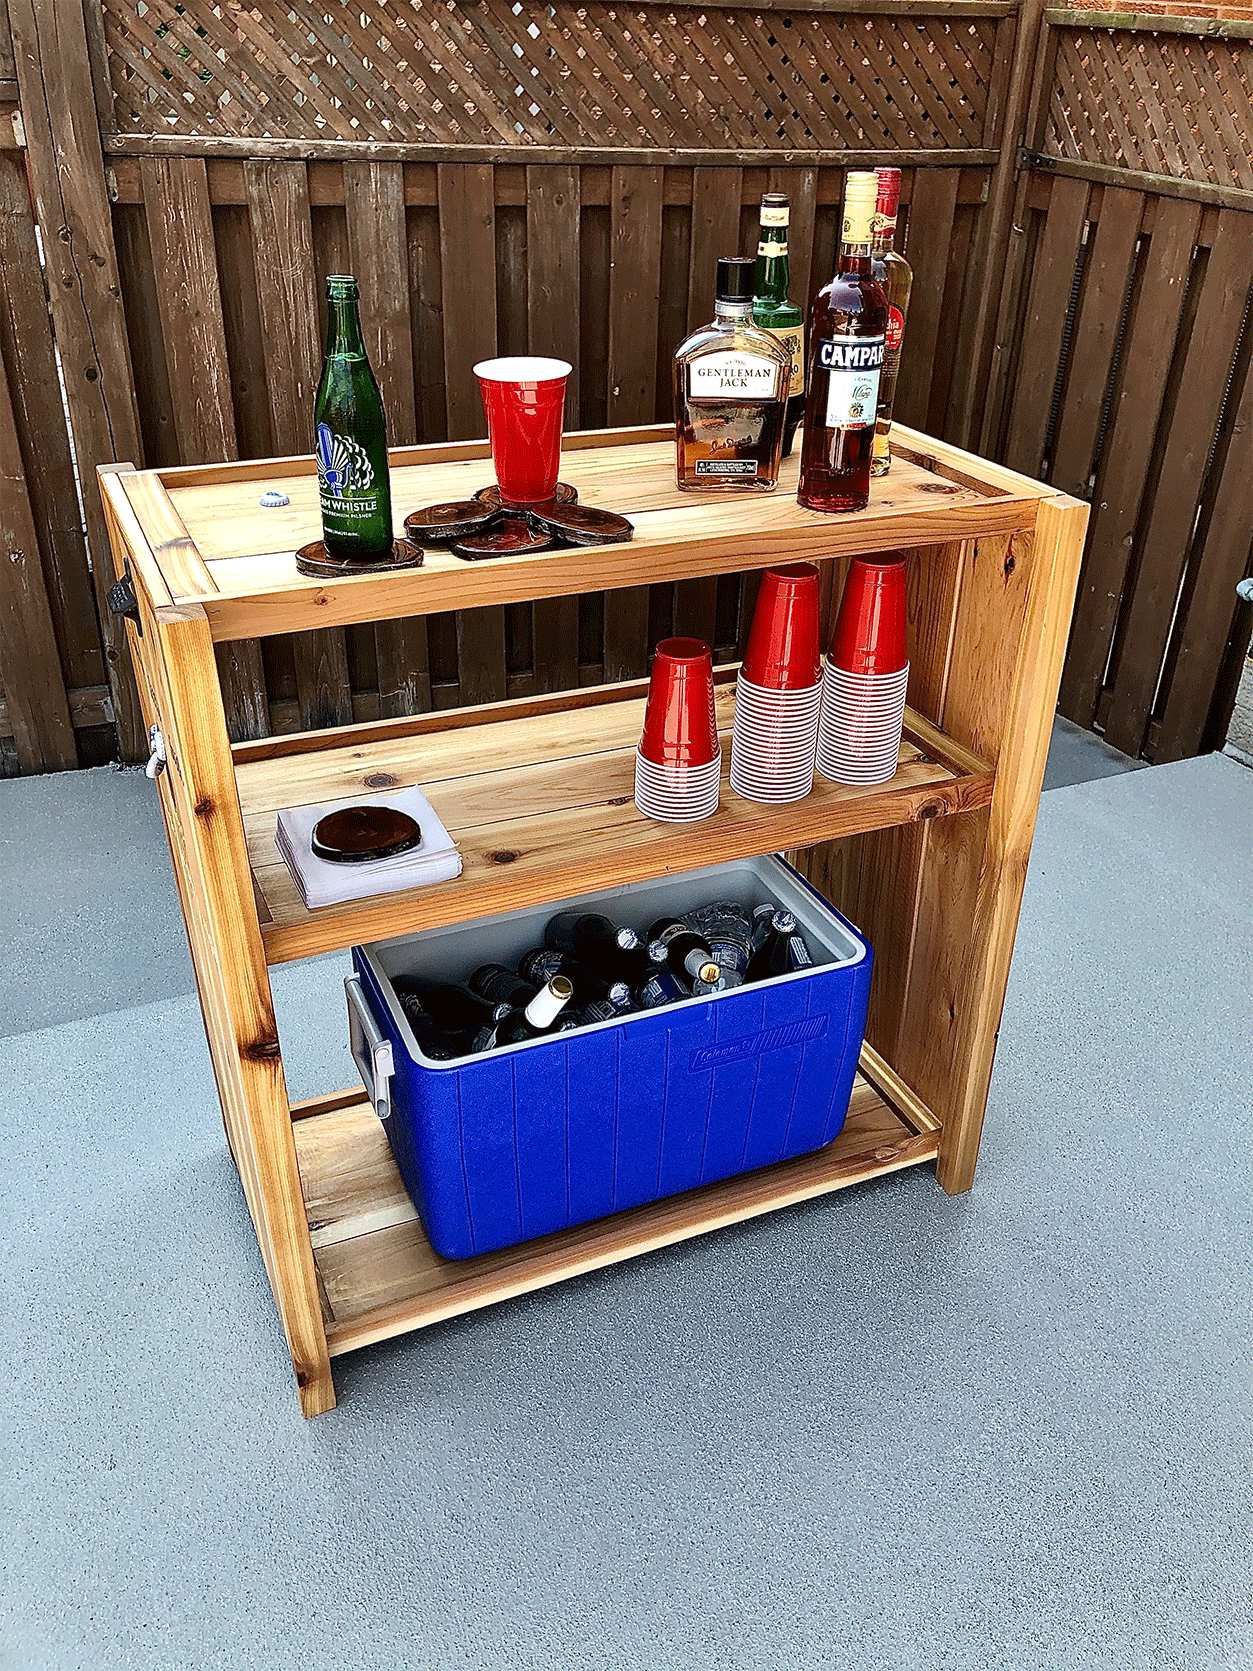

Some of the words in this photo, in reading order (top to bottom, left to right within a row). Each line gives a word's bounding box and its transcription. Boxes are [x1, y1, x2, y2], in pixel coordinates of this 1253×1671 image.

[697, 368, 772, 378] GENTLEMAN
[719, 378, 748, 388] JACK
[331, 501, 377, 511] WHISTLE
